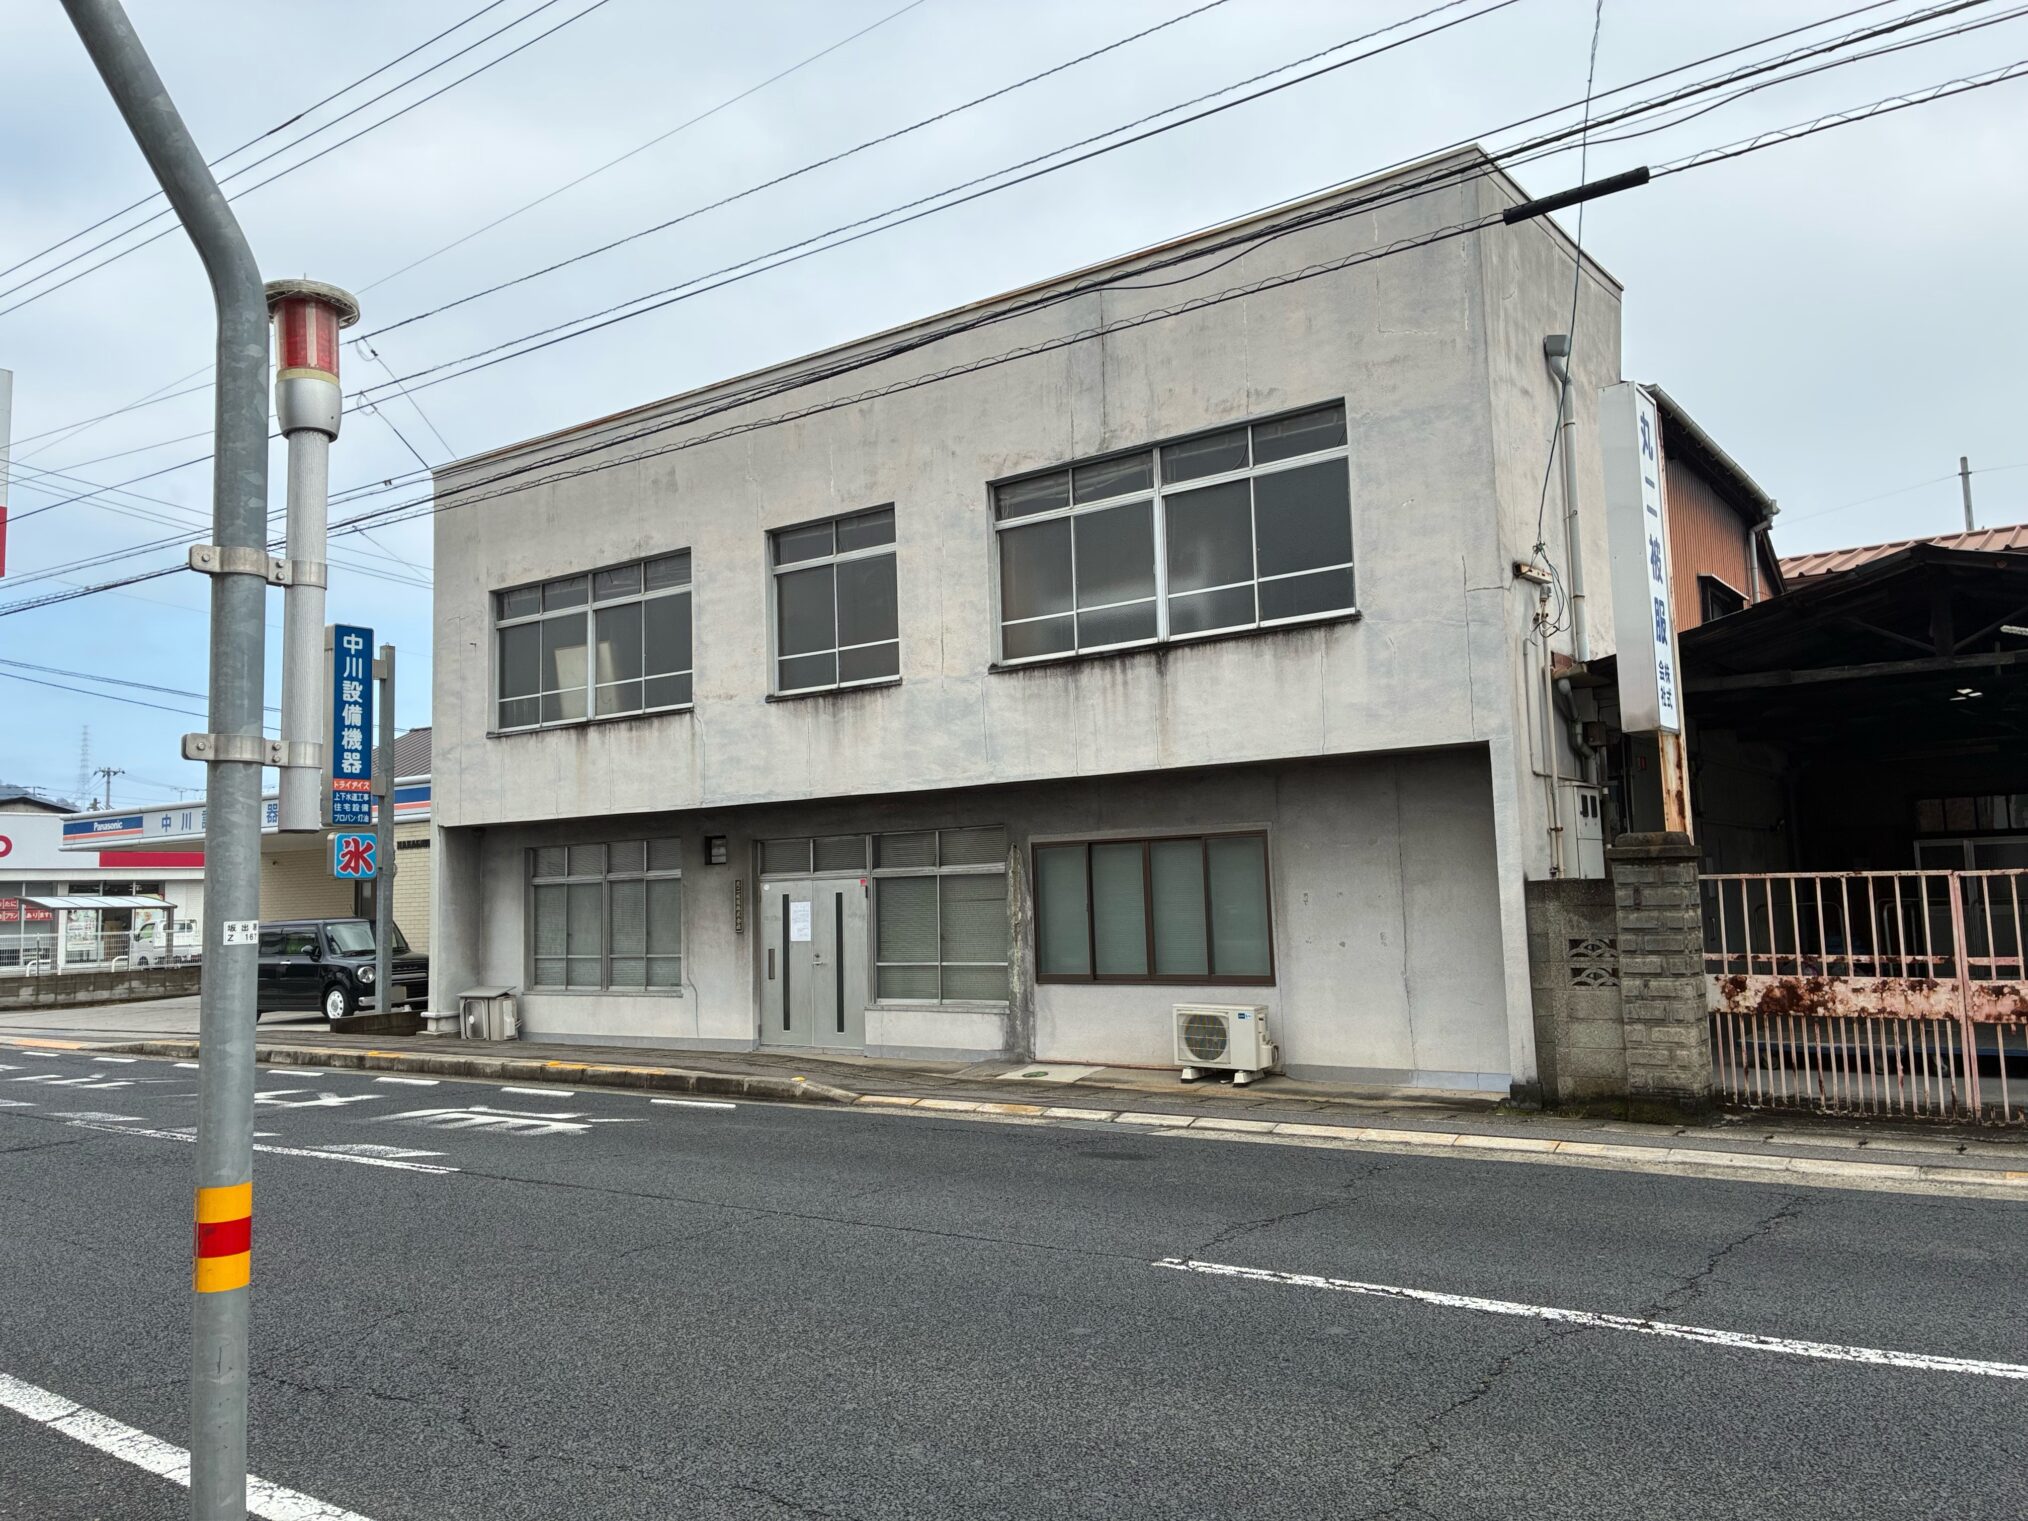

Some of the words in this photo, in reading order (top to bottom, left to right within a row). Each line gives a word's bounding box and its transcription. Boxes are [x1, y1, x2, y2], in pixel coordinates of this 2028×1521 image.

[1640, 411, 1668, 645] 丸二被服
[341, 633, 363, 774] 中川設備機器
[334, 792, 369, 801] 上下水道工事
[334, 803, 369, 812] 住宅設備
[93, 819, 123, 831] Panasonic
[339, 837, 374, 875] 氷
